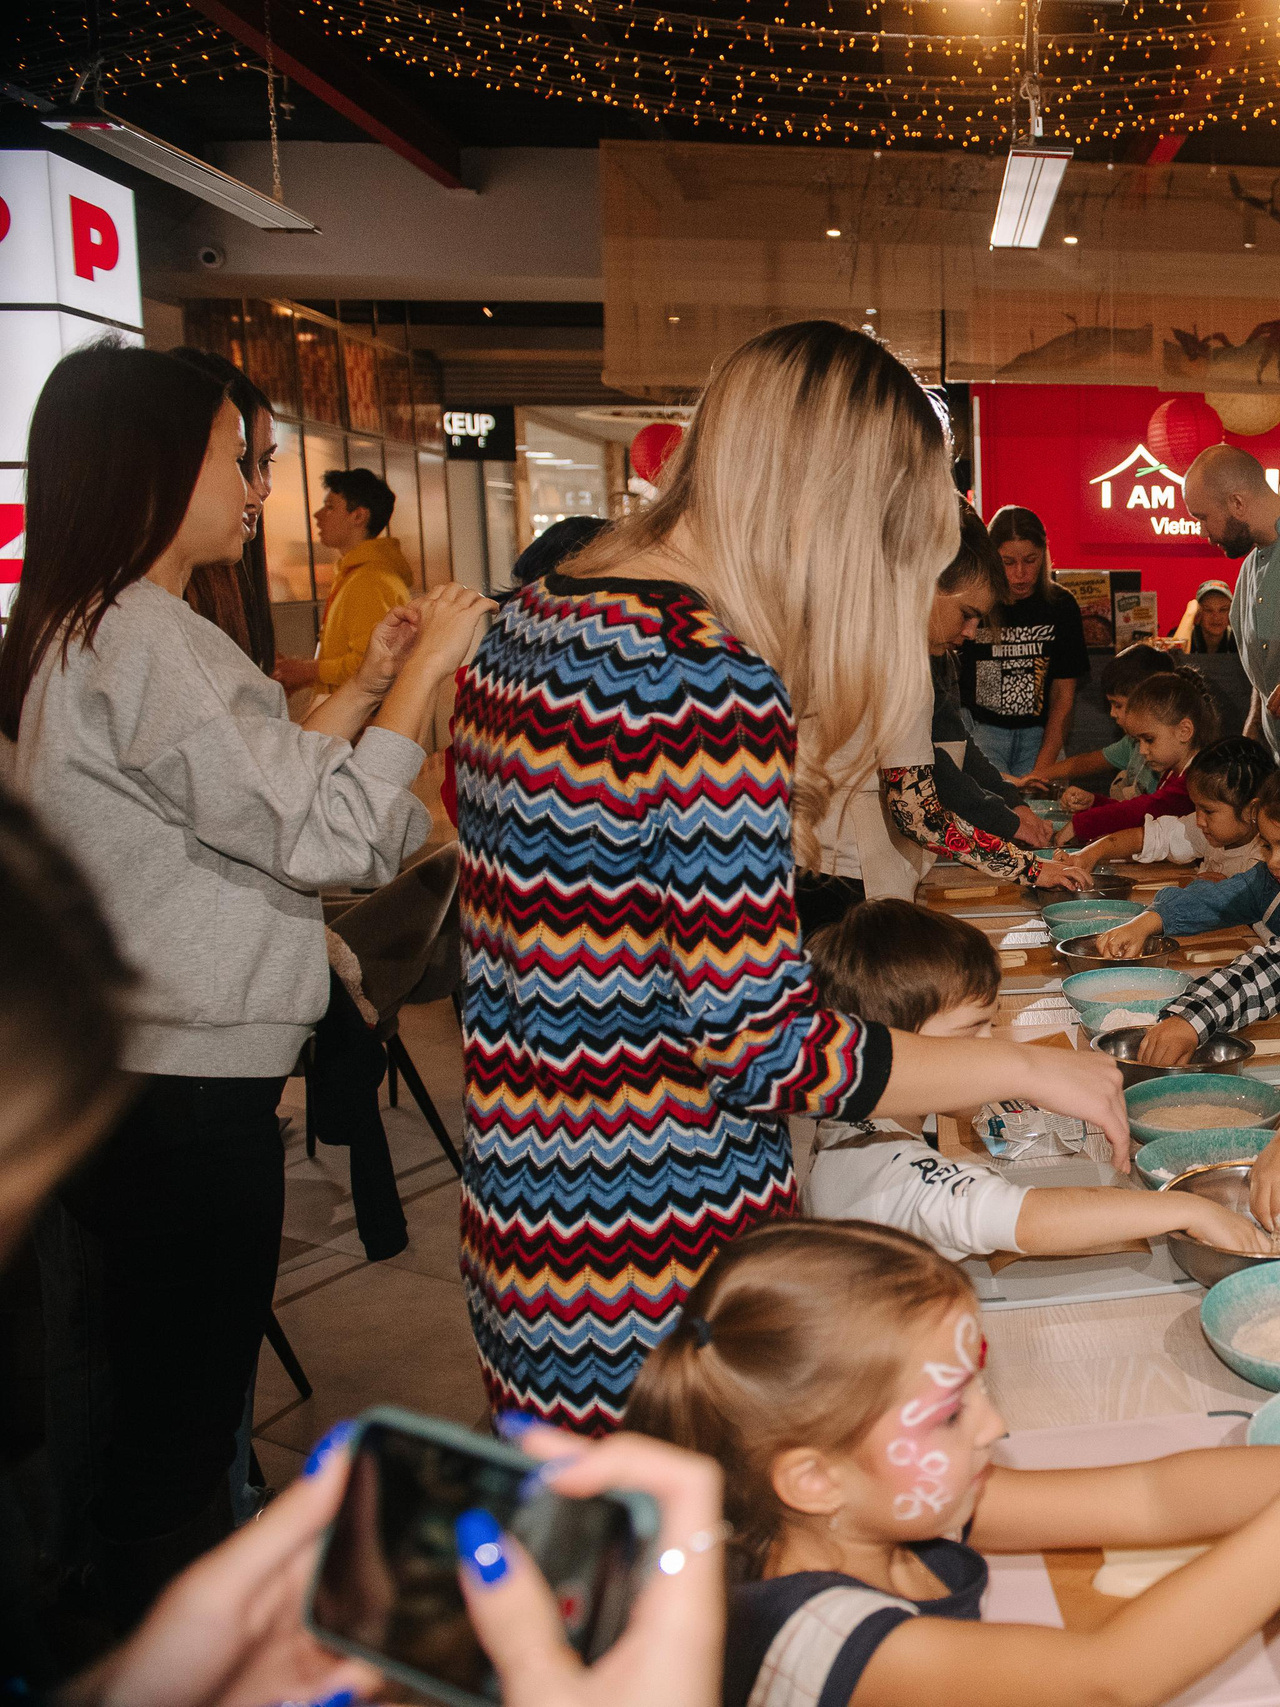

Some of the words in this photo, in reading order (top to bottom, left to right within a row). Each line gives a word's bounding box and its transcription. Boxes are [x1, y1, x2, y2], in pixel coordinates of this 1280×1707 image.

[1101, 481, 1112, 509] I
[1126, 485, 1176, 509] AM
[991, 642, 1044, 658] DIFFERENTLY
